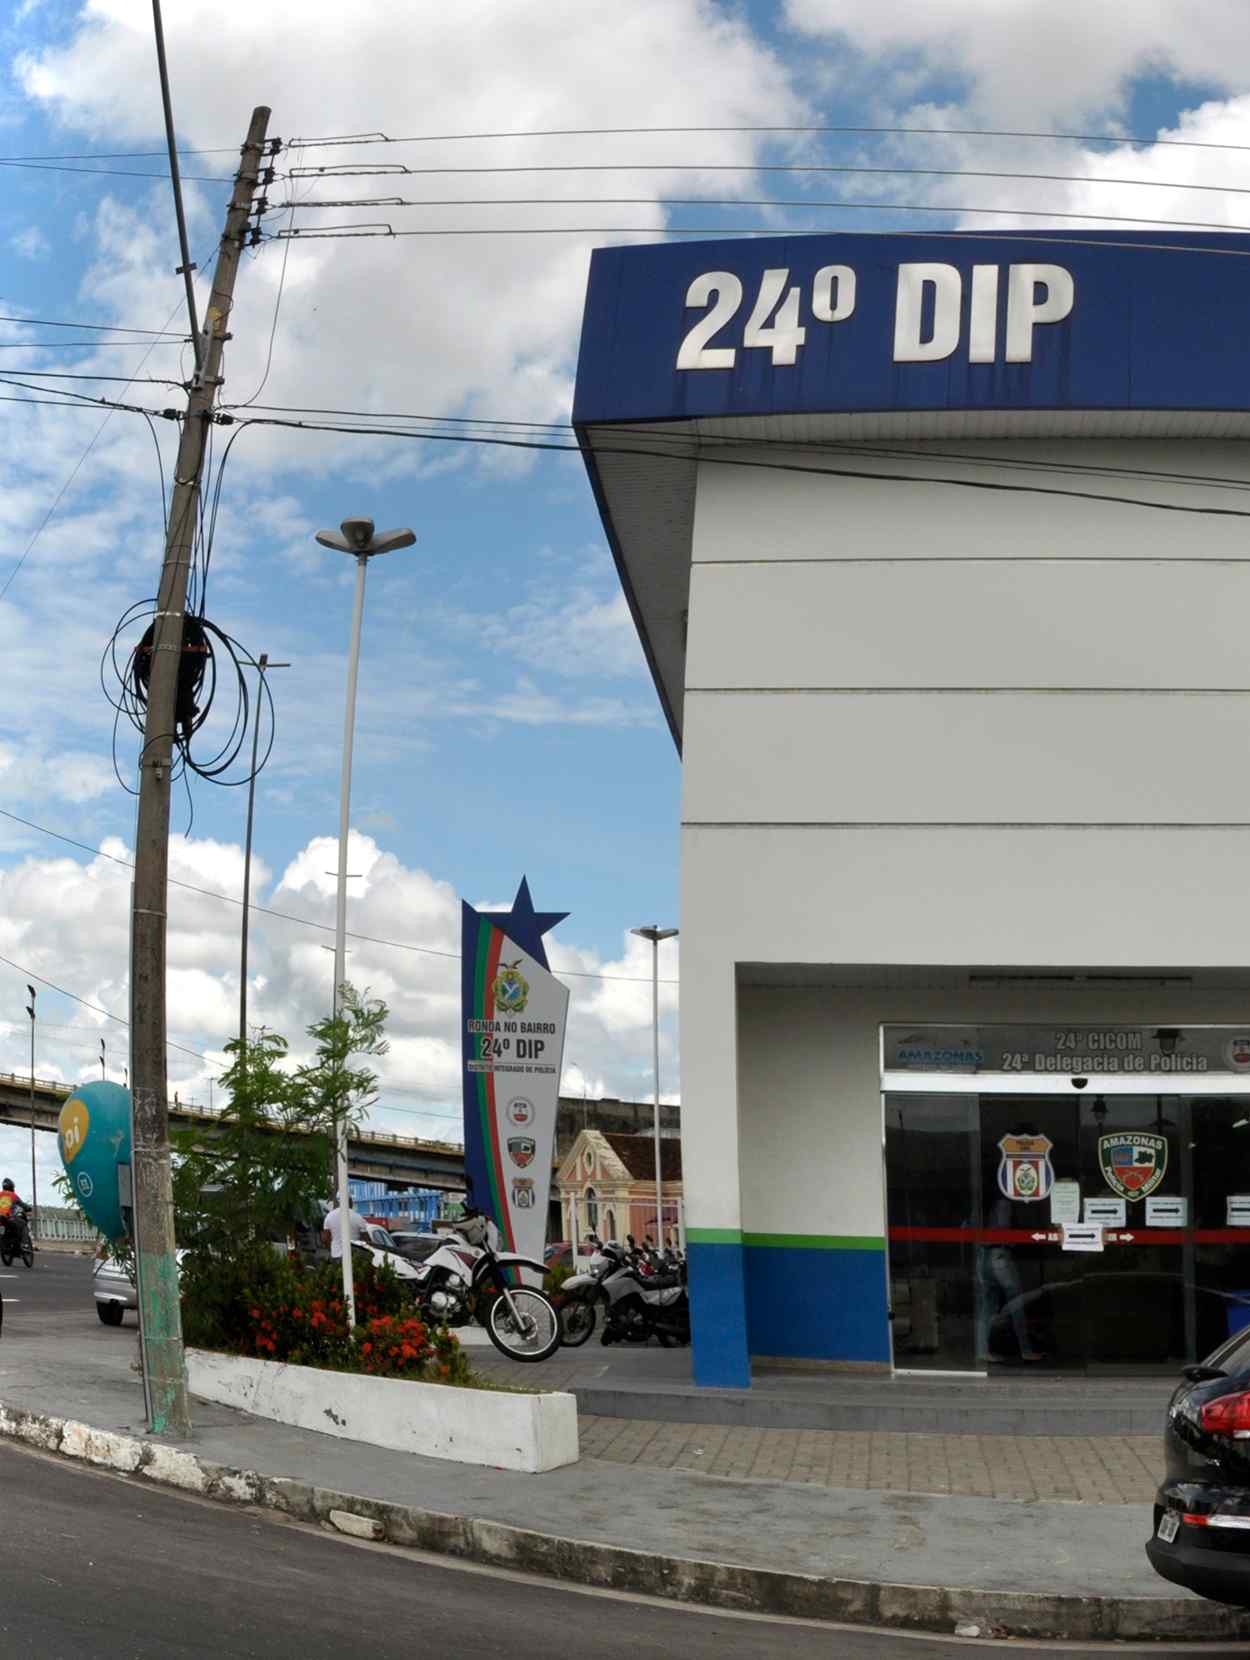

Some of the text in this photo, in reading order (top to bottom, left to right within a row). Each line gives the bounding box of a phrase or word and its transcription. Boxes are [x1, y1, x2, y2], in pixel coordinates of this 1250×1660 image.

[676, 263, 1074, 370] 24º DIP
[467, 1020, 556, 1034] RONDA NO BAIRRO
[516, 1039, 546, 1059] DIP
[1088, 1032, 1141, 1049] CICOM
[1035, 1053, 1119, 1073] Delegacia
[1124, 1054, 1144, 1070] de
[65, 1117, 80, 1149] oi
[1103, 1136, 1163, 1150] AMAZONAS
